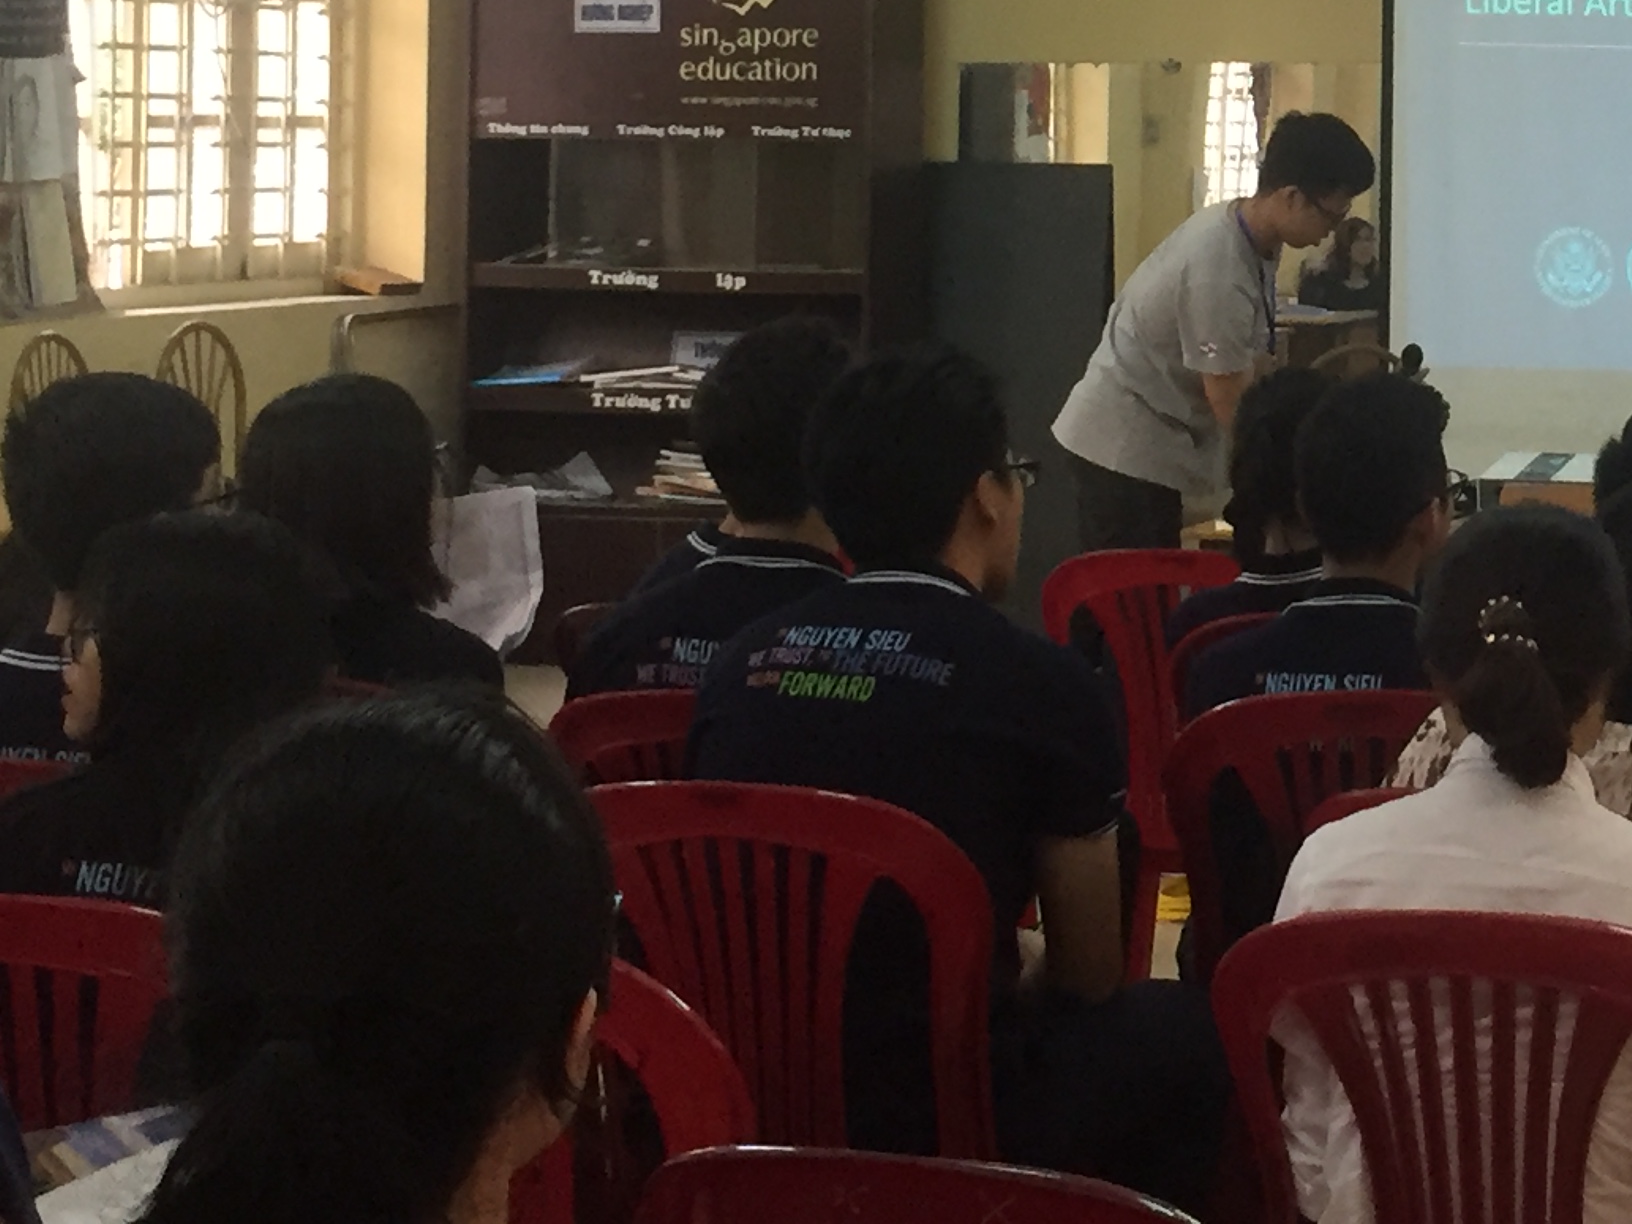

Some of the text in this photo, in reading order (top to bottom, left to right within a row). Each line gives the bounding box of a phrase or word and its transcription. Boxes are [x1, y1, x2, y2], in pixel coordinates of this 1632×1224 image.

[680, 23, 819, 56] singapore
[679, 56, 818, 81] education
[588, 269, 747, 291] Trường lập
[591, 392, 662, 412] Trường
[784, 626, 861, 649] NGUYEN
[865, 629, 913, 653] SIEU
[778, 671, 876, 702] FORWARD
